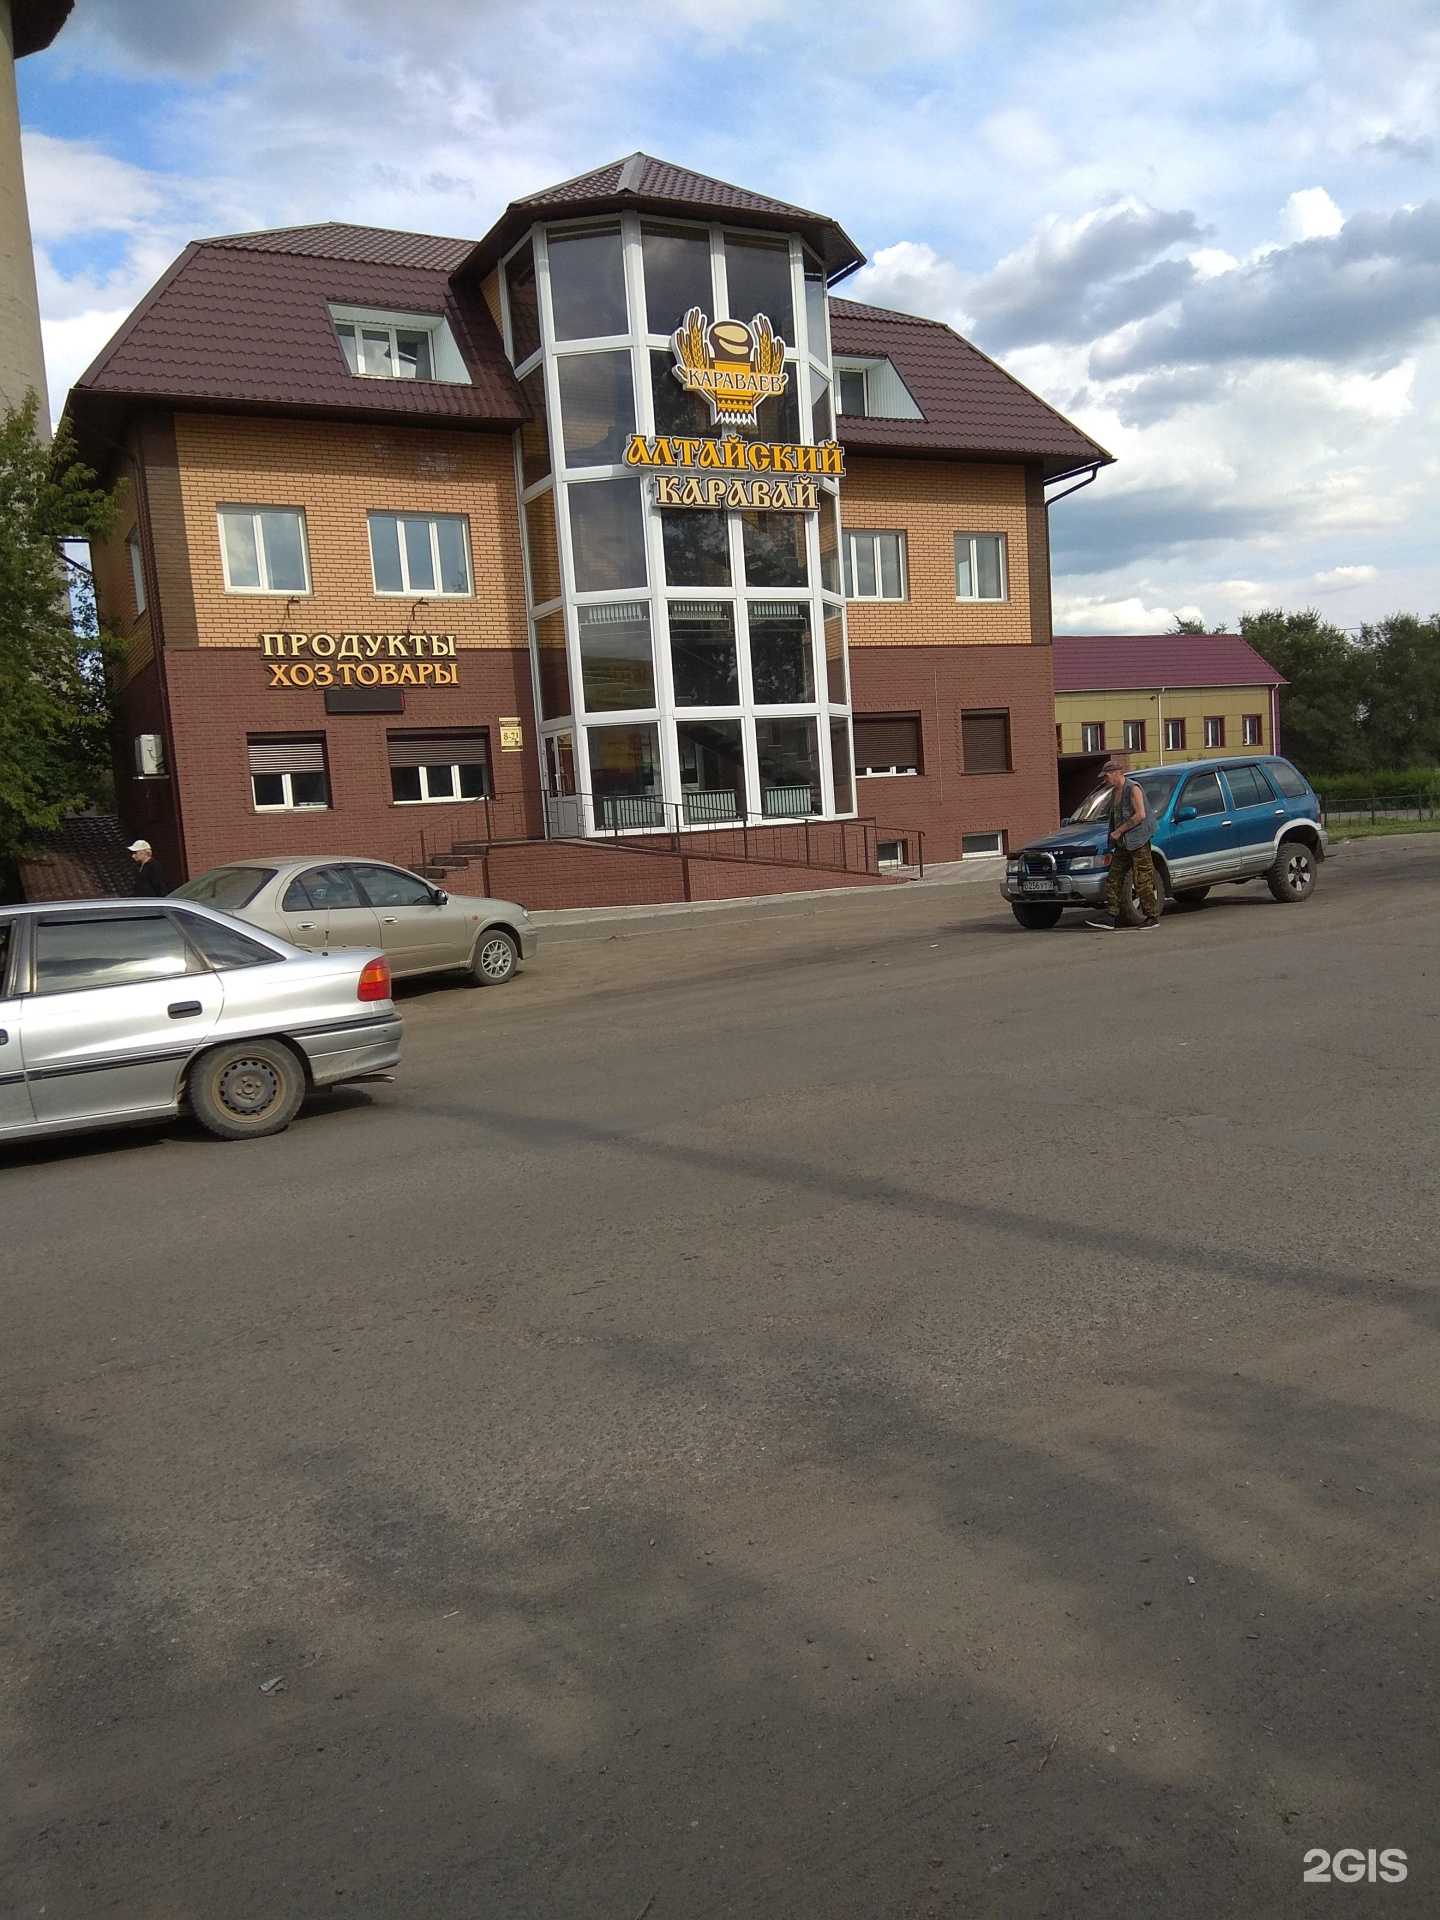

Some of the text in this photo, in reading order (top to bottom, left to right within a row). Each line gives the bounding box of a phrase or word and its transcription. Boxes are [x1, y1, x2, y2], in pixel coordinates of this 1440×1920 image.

[688, 370, 783, 393] КАРАВАЕВ
[625, 433, 845, 475] АЛТАЙСКИЙ
[656, 475, 820, 510] КАРАВАЙ
[261, 633, 457, 661] ПРОДУКТЫ
